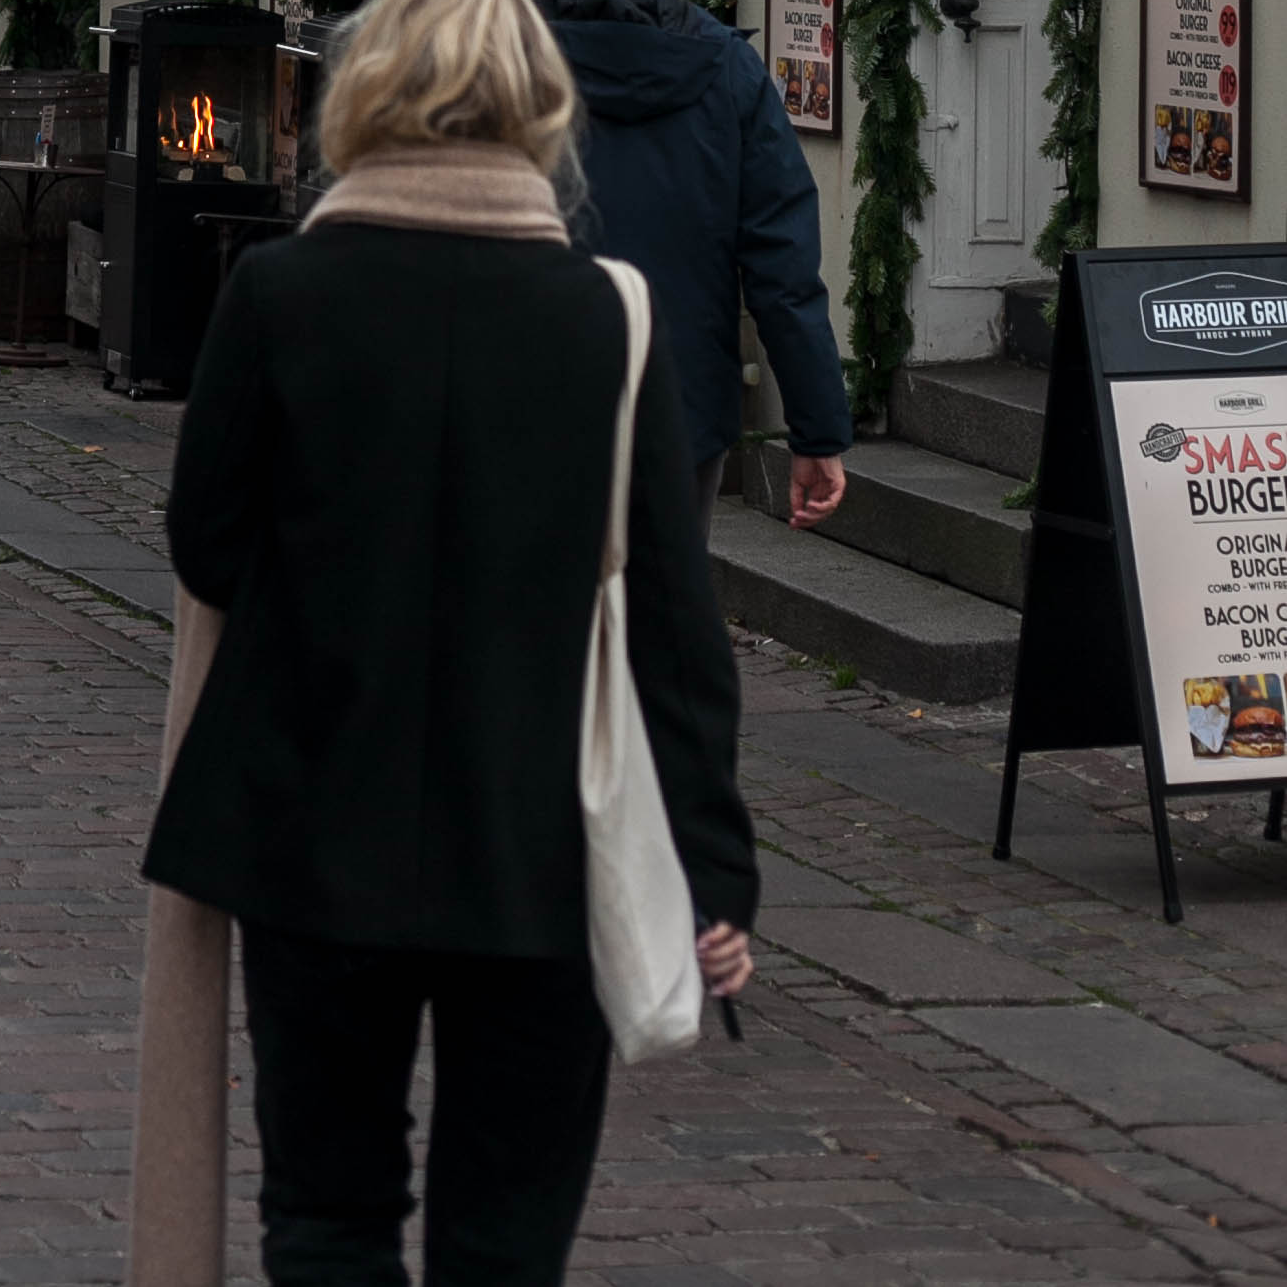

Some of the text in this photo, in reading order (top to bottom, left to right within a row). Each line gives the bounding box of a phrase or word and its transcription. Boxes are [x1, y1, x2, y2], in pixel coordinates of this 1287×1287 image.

[785, 11, 803, 26] BACON
[1180, 14, 1209, 31] BURGER
[1220, 11, 1237, 35] 99
[793, 28, 812, 43] BURGER
[1167, 50, 1221, 70] BACON CHEESE
[1179, 70, 1208, 88] BURGER
[1222, 72, 1237, 95] 119
[1152, 299, 1287, 328] HARBOUR GRI
[1196, 329, 1272, 340] BAROCK NYHAVN
[1219, 396, 1264, 407] HARBOUR GRILL
[1183, 432, 1287, 474] SMAS
[1187, 476, 1287, 516] BURGE
[1217, 533, 1287, 555] ORIGIN
[1208, 583, 1241, 593] COMBO
[1249, 581, 1270, 591] WITH
[1204, 604, 1269, 626] BACON
[1218, 652, 1251, 663] COMBO
[1258, 651, 1281, 661] WITH
